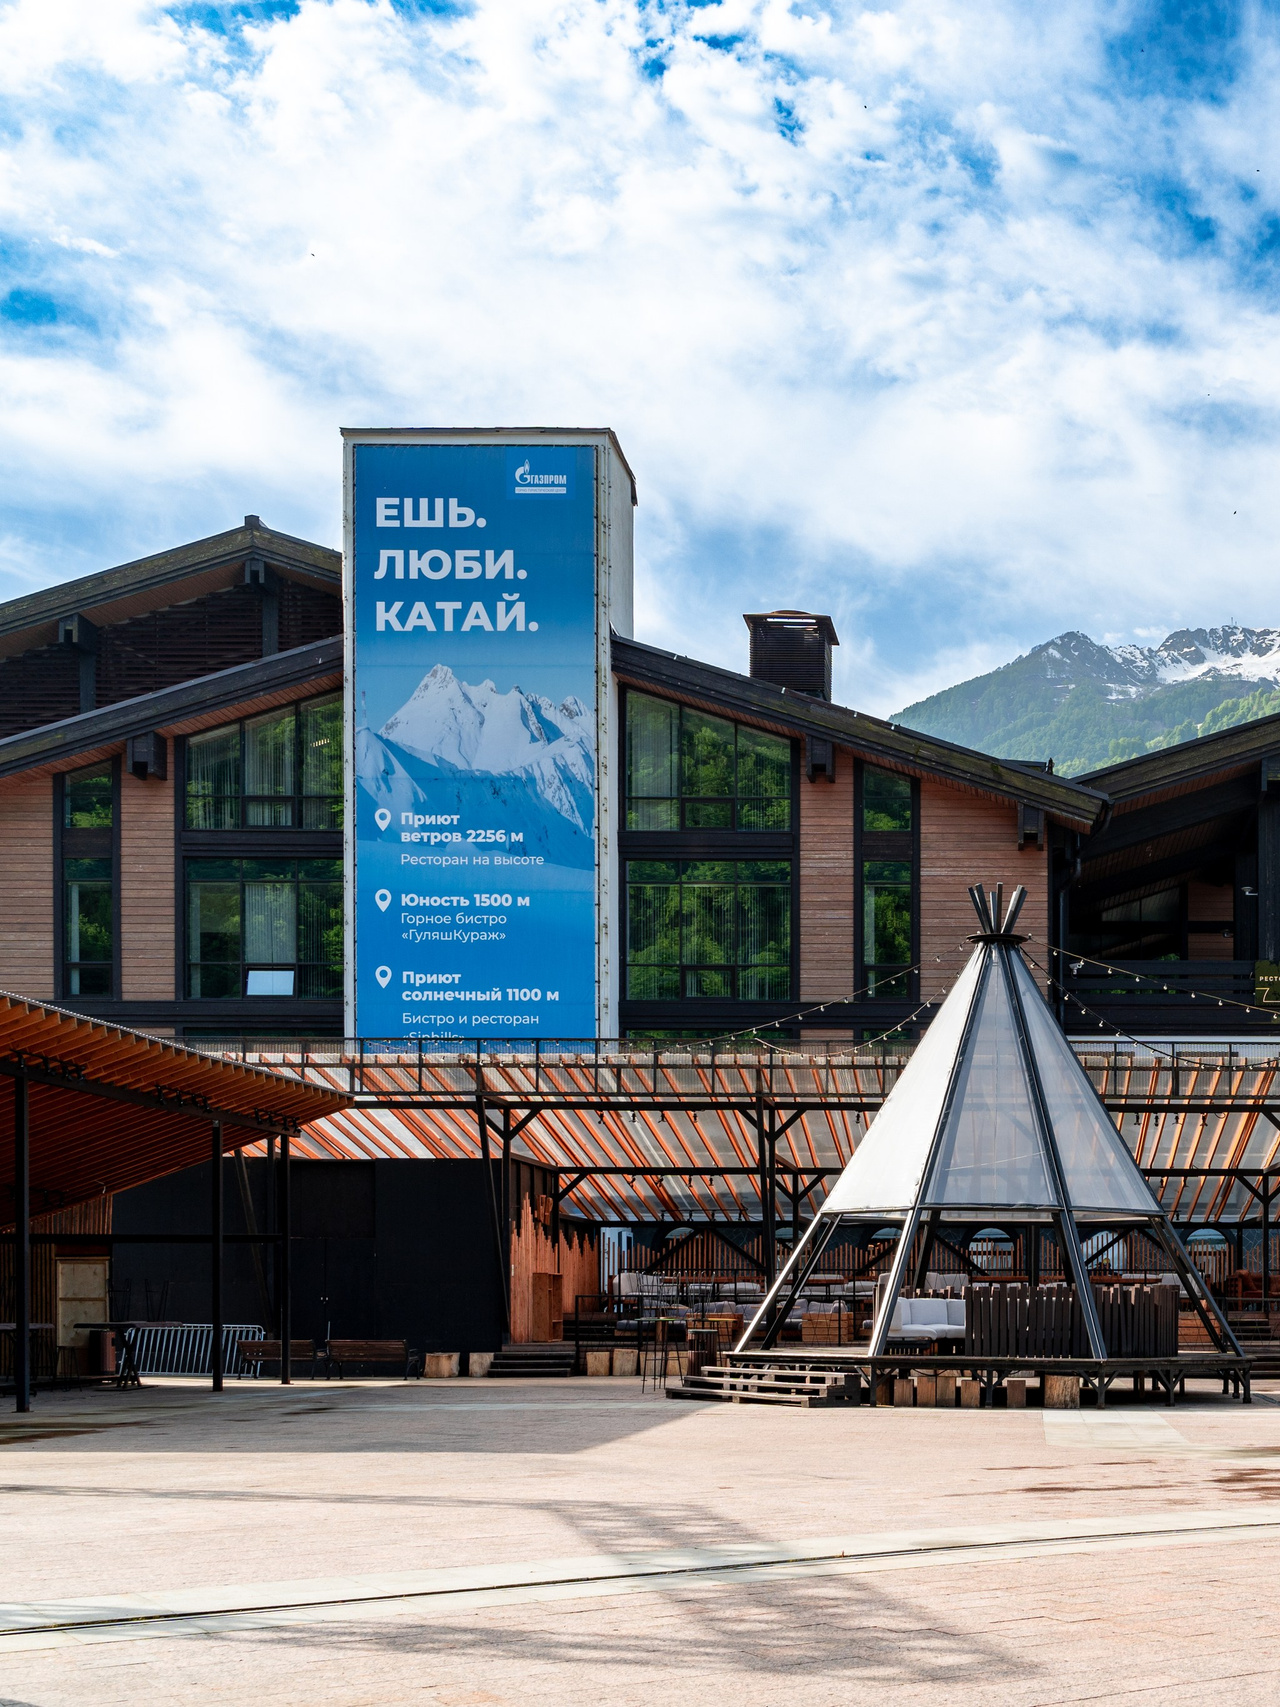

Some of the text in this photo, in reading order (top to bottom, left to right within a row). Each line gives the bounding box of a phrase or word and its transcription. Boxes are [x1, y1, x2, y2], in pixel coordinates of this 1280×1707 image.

[530, 475, 566, 484] ГАЗПРОМ
[376, 498, 486, 527] ЕШЬ.
[374, 550, 527, 579] ЛЮБИ.
[376, 593, 538, 631] КАТАЙ.
[401, 812, 460, 829] Приют
[401, 829, 524, 846] ветров 2256 м
[400, 854, 544, 869] Ресторан на высоте
[402, 894, 529, 906] Юность 1500 м
[402, 913, 506, 926] Горное бистро
[402, 930, 505, 942] «ГуляшКураж»
[403, 972, 461, 986] Приют
[402, 987, 558, 1001] солнечный 1100 м
[403, 1013, 454, 1026] Бистро
[473, 1016, 538, 1026] ресторан
